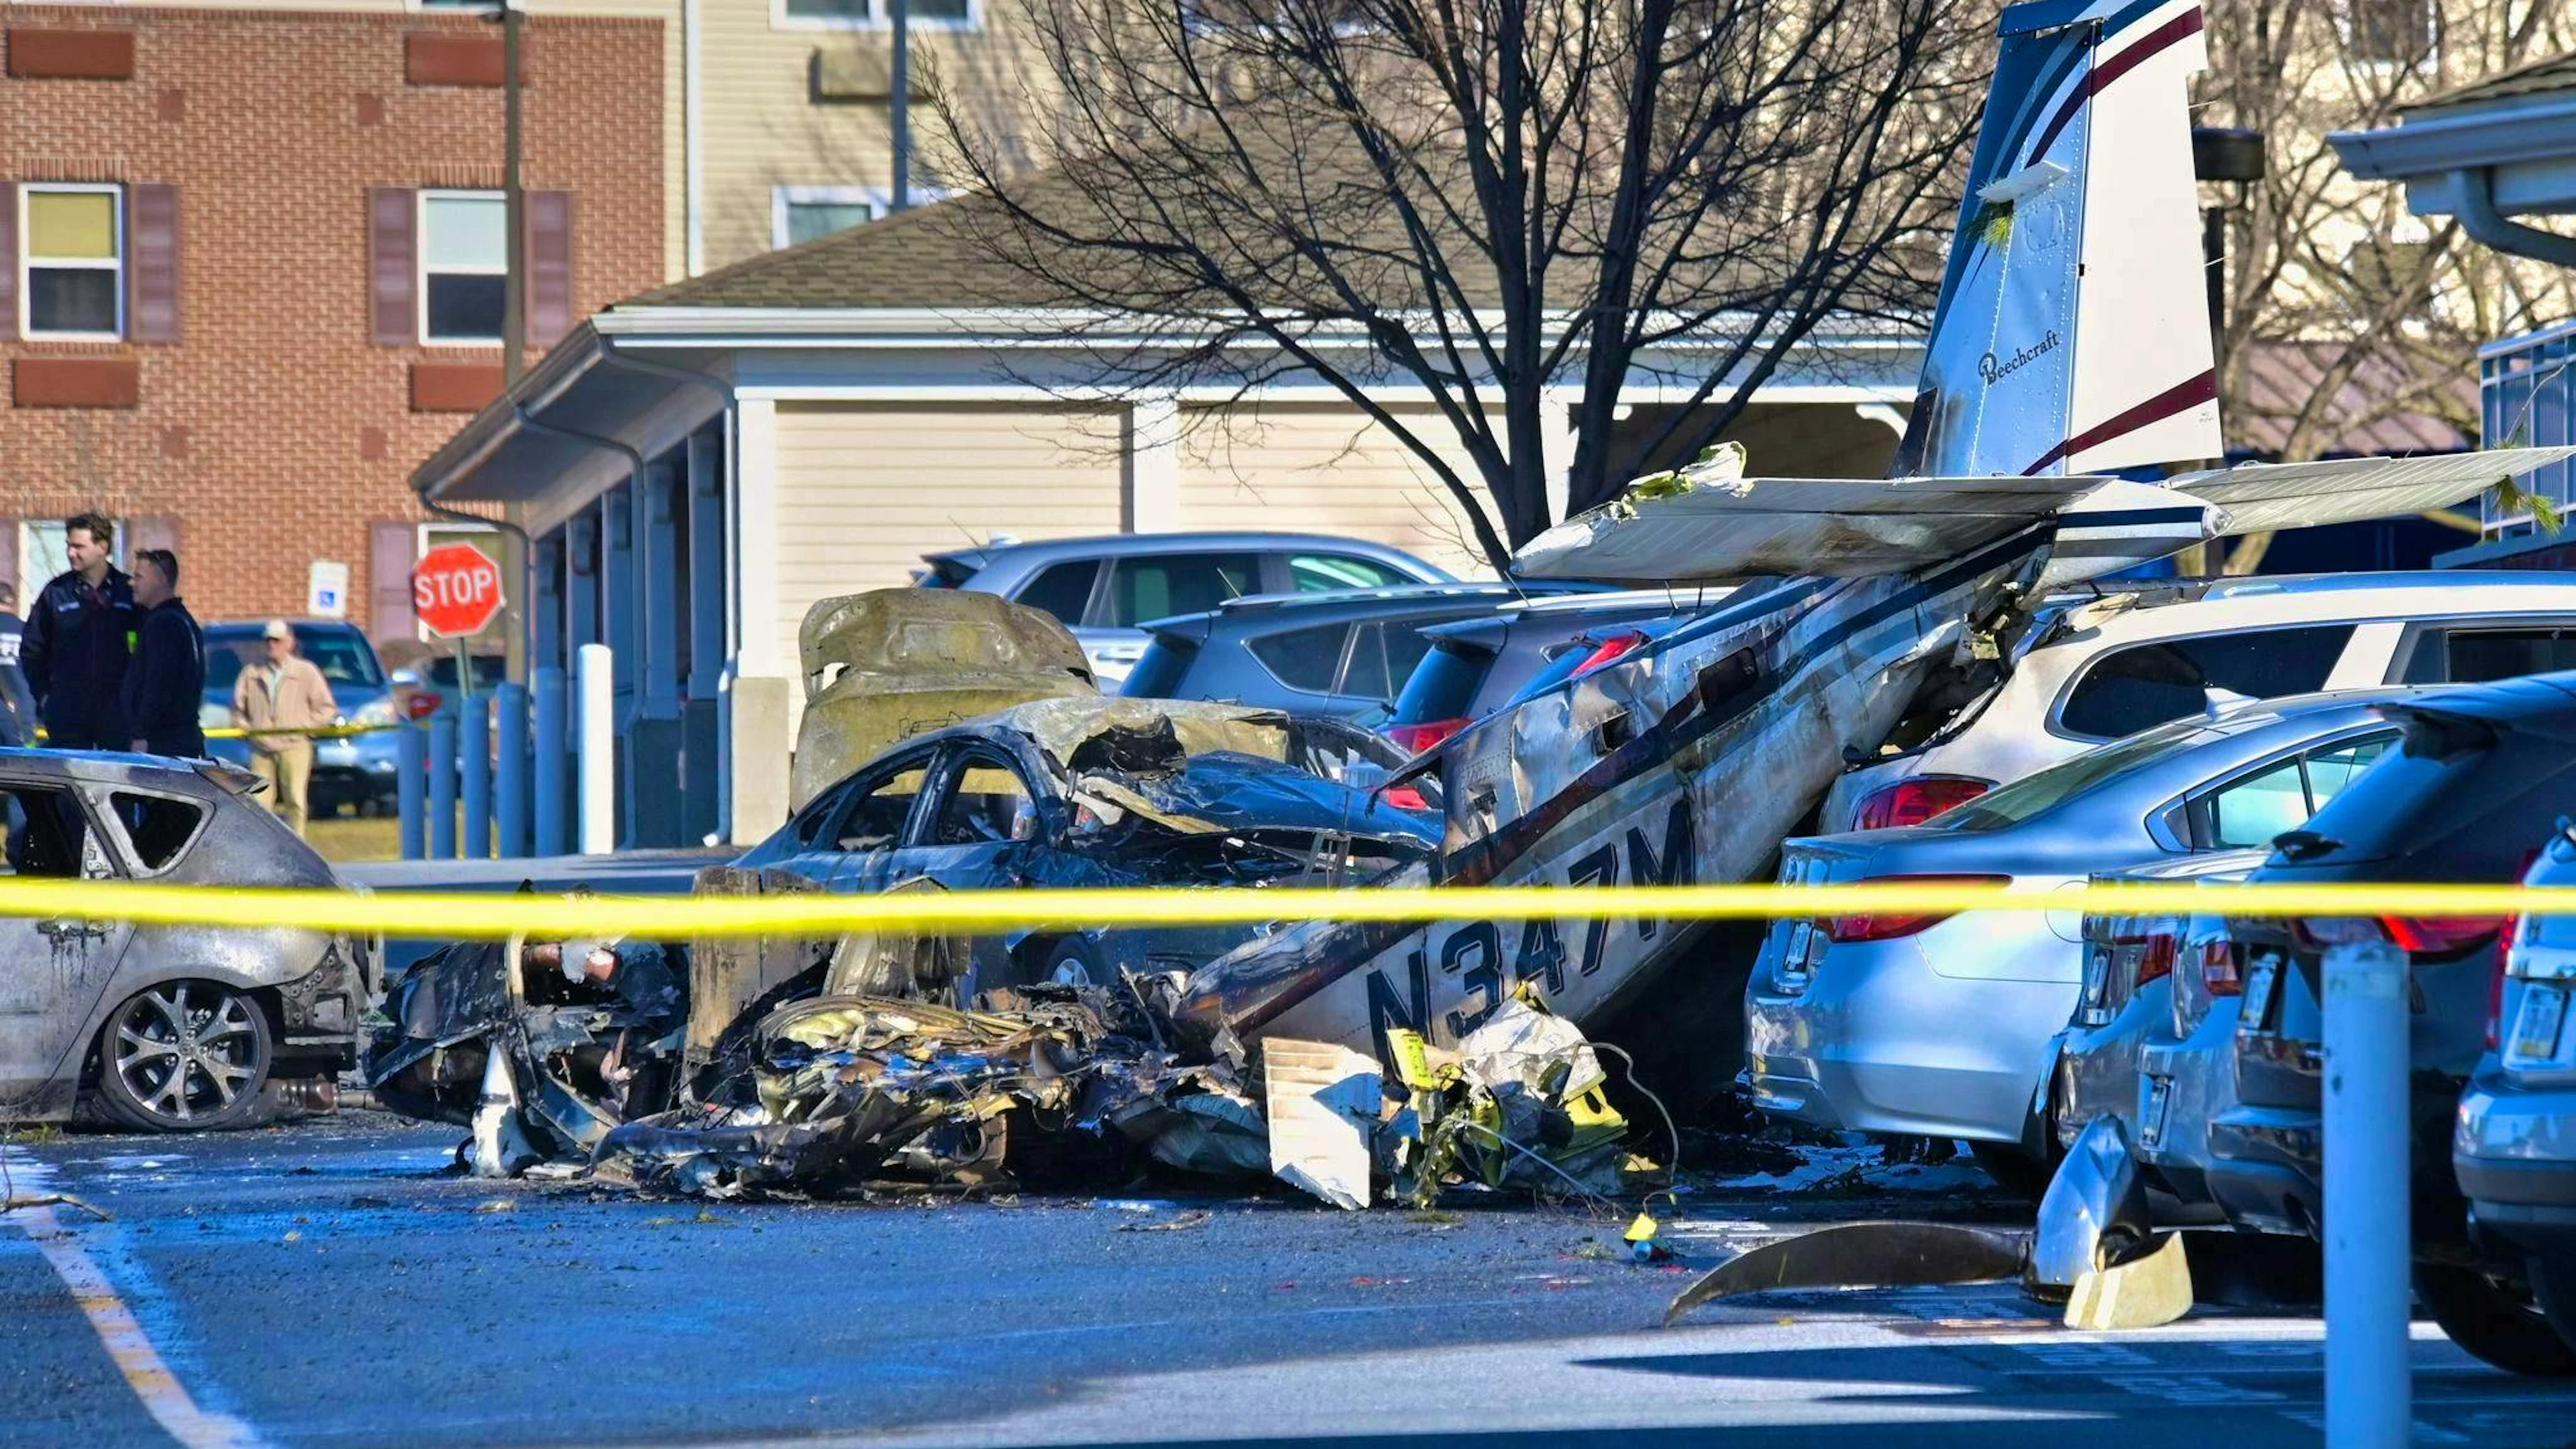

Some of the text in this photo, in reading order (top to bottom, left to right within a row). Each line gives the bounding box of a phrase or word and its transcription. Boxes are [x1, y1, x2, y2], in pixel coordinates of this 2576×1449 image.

[1978, 329, 2059, 386] Beechcraft
[415, 567, 492, 608] STOP
[1366, 800, 1697, 1083] N347M
